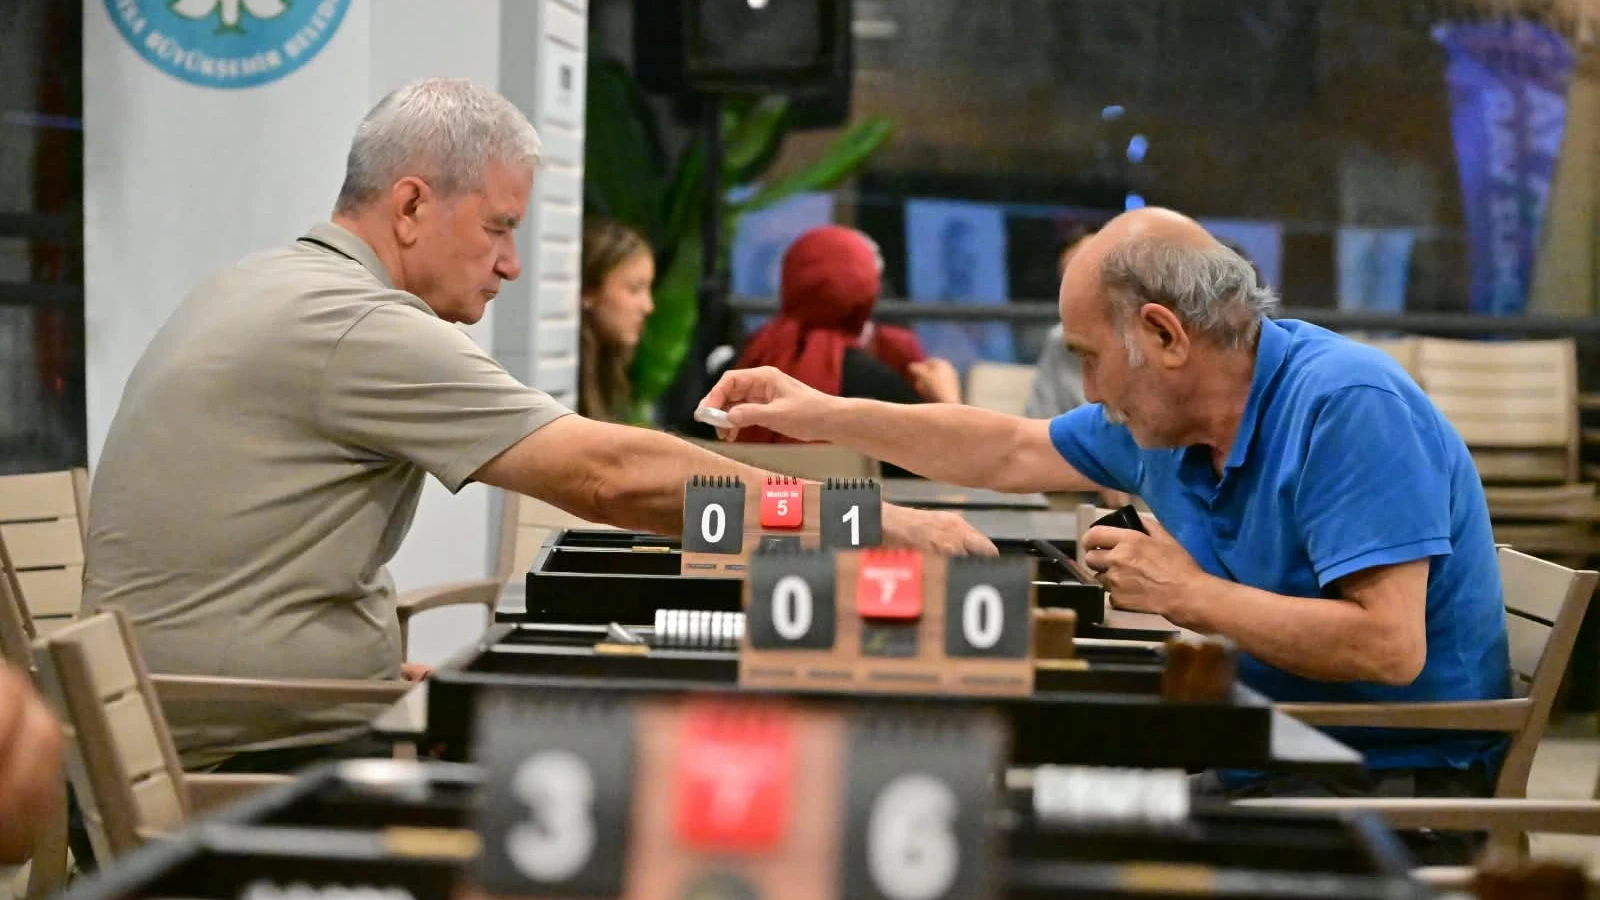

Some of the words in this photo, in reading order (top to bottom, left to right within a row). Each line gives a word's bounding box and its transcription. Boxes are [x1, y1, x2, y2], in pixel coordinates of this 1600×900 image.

[701, 503, 726, 544] 0
[776, 499, 788, 516] 5
[842, 505, 860, 546] 1
[771, 575, 813, 640] 0
[878, 578, 899, 606] 7
[962, 584, 1004, 649] 0
[504, 748, 594, 883] 3
[866, 773, 960, 900] 6
